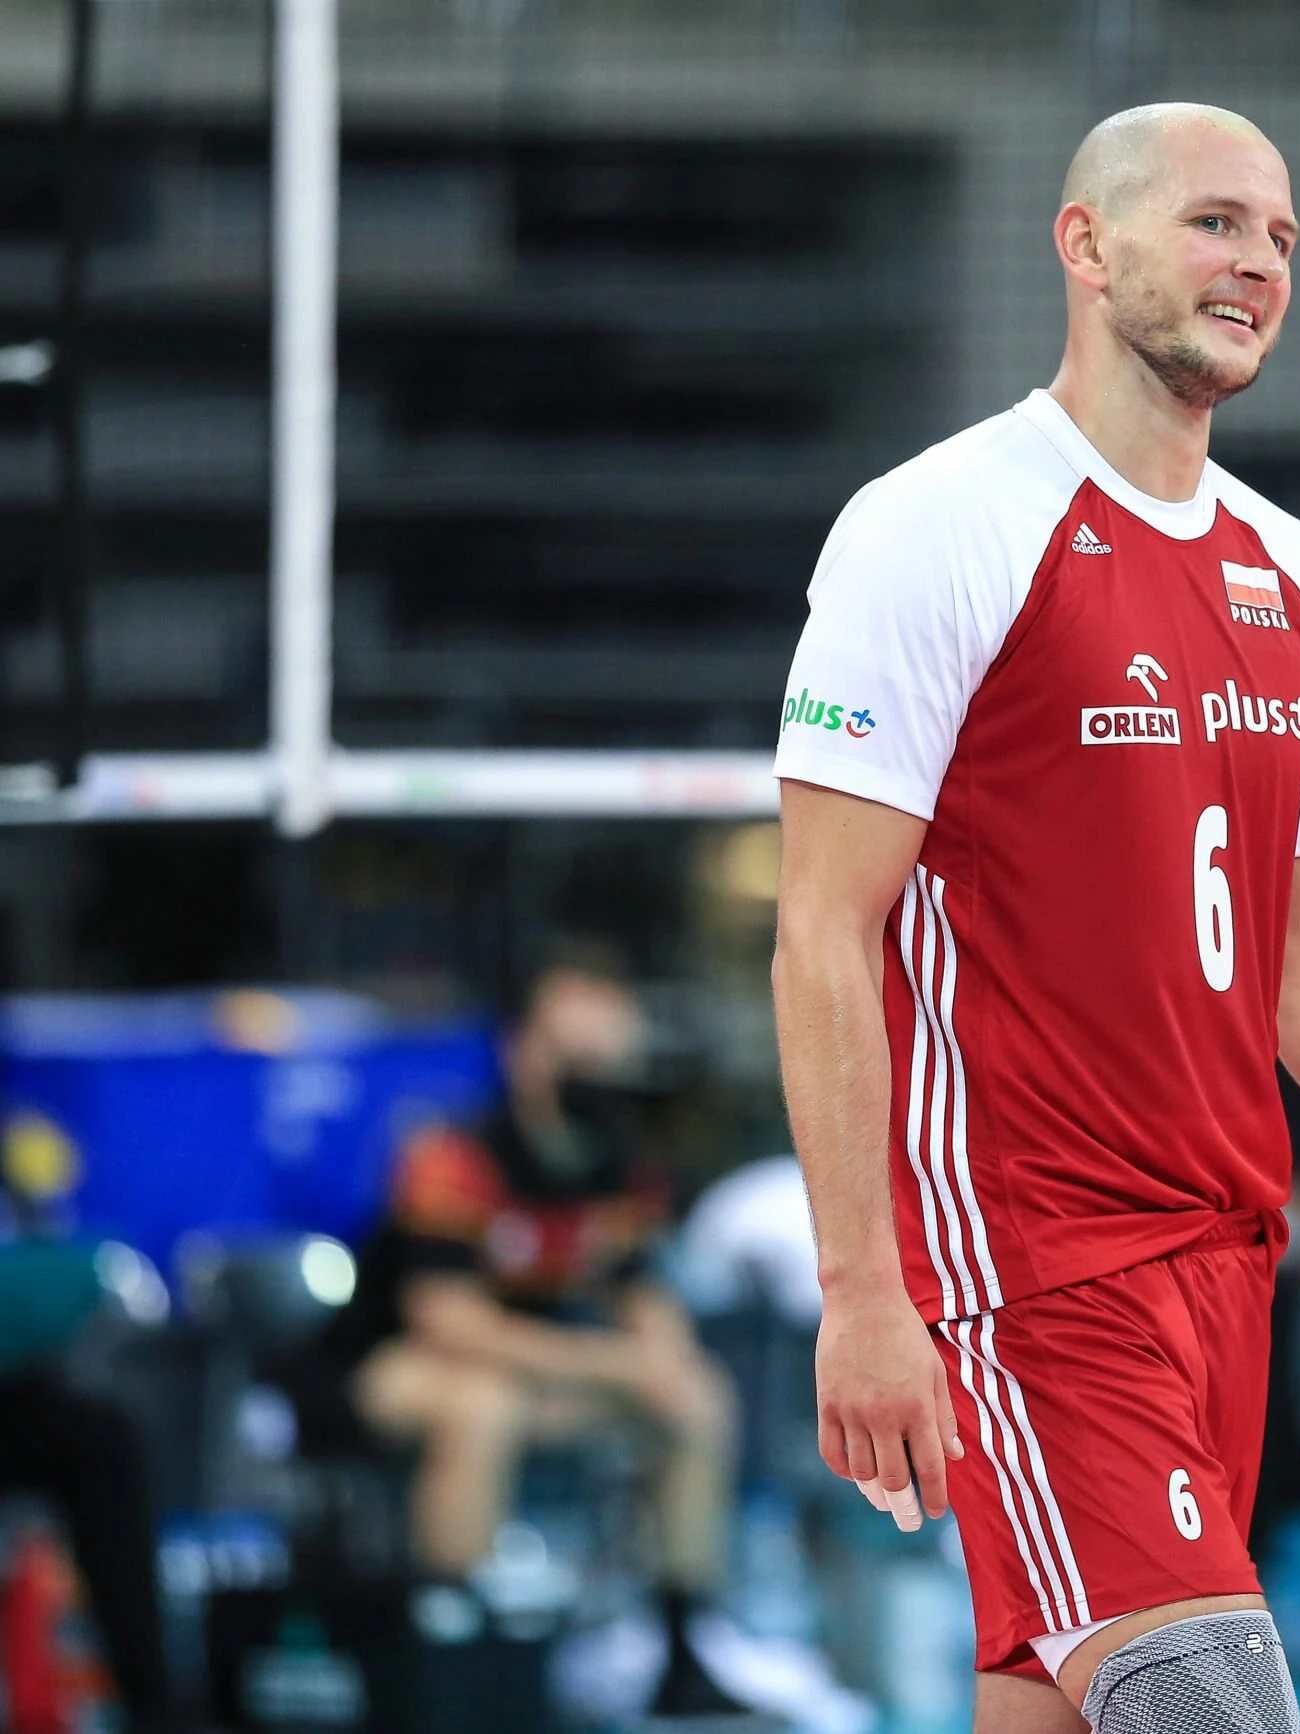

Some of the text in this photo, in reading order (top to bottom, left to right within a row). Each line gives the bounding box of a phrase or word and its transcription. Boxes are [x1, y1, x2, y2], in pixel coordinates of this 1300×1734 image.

[1071, 542, 1112, 555] adidas
[1230, 604, 1291, 631] POLSKA
[1089, 712, 1176, 739] ORLEN
[1193, 804, 1234, 992] 6
[1168, 1468, 1202, 1541] 6
